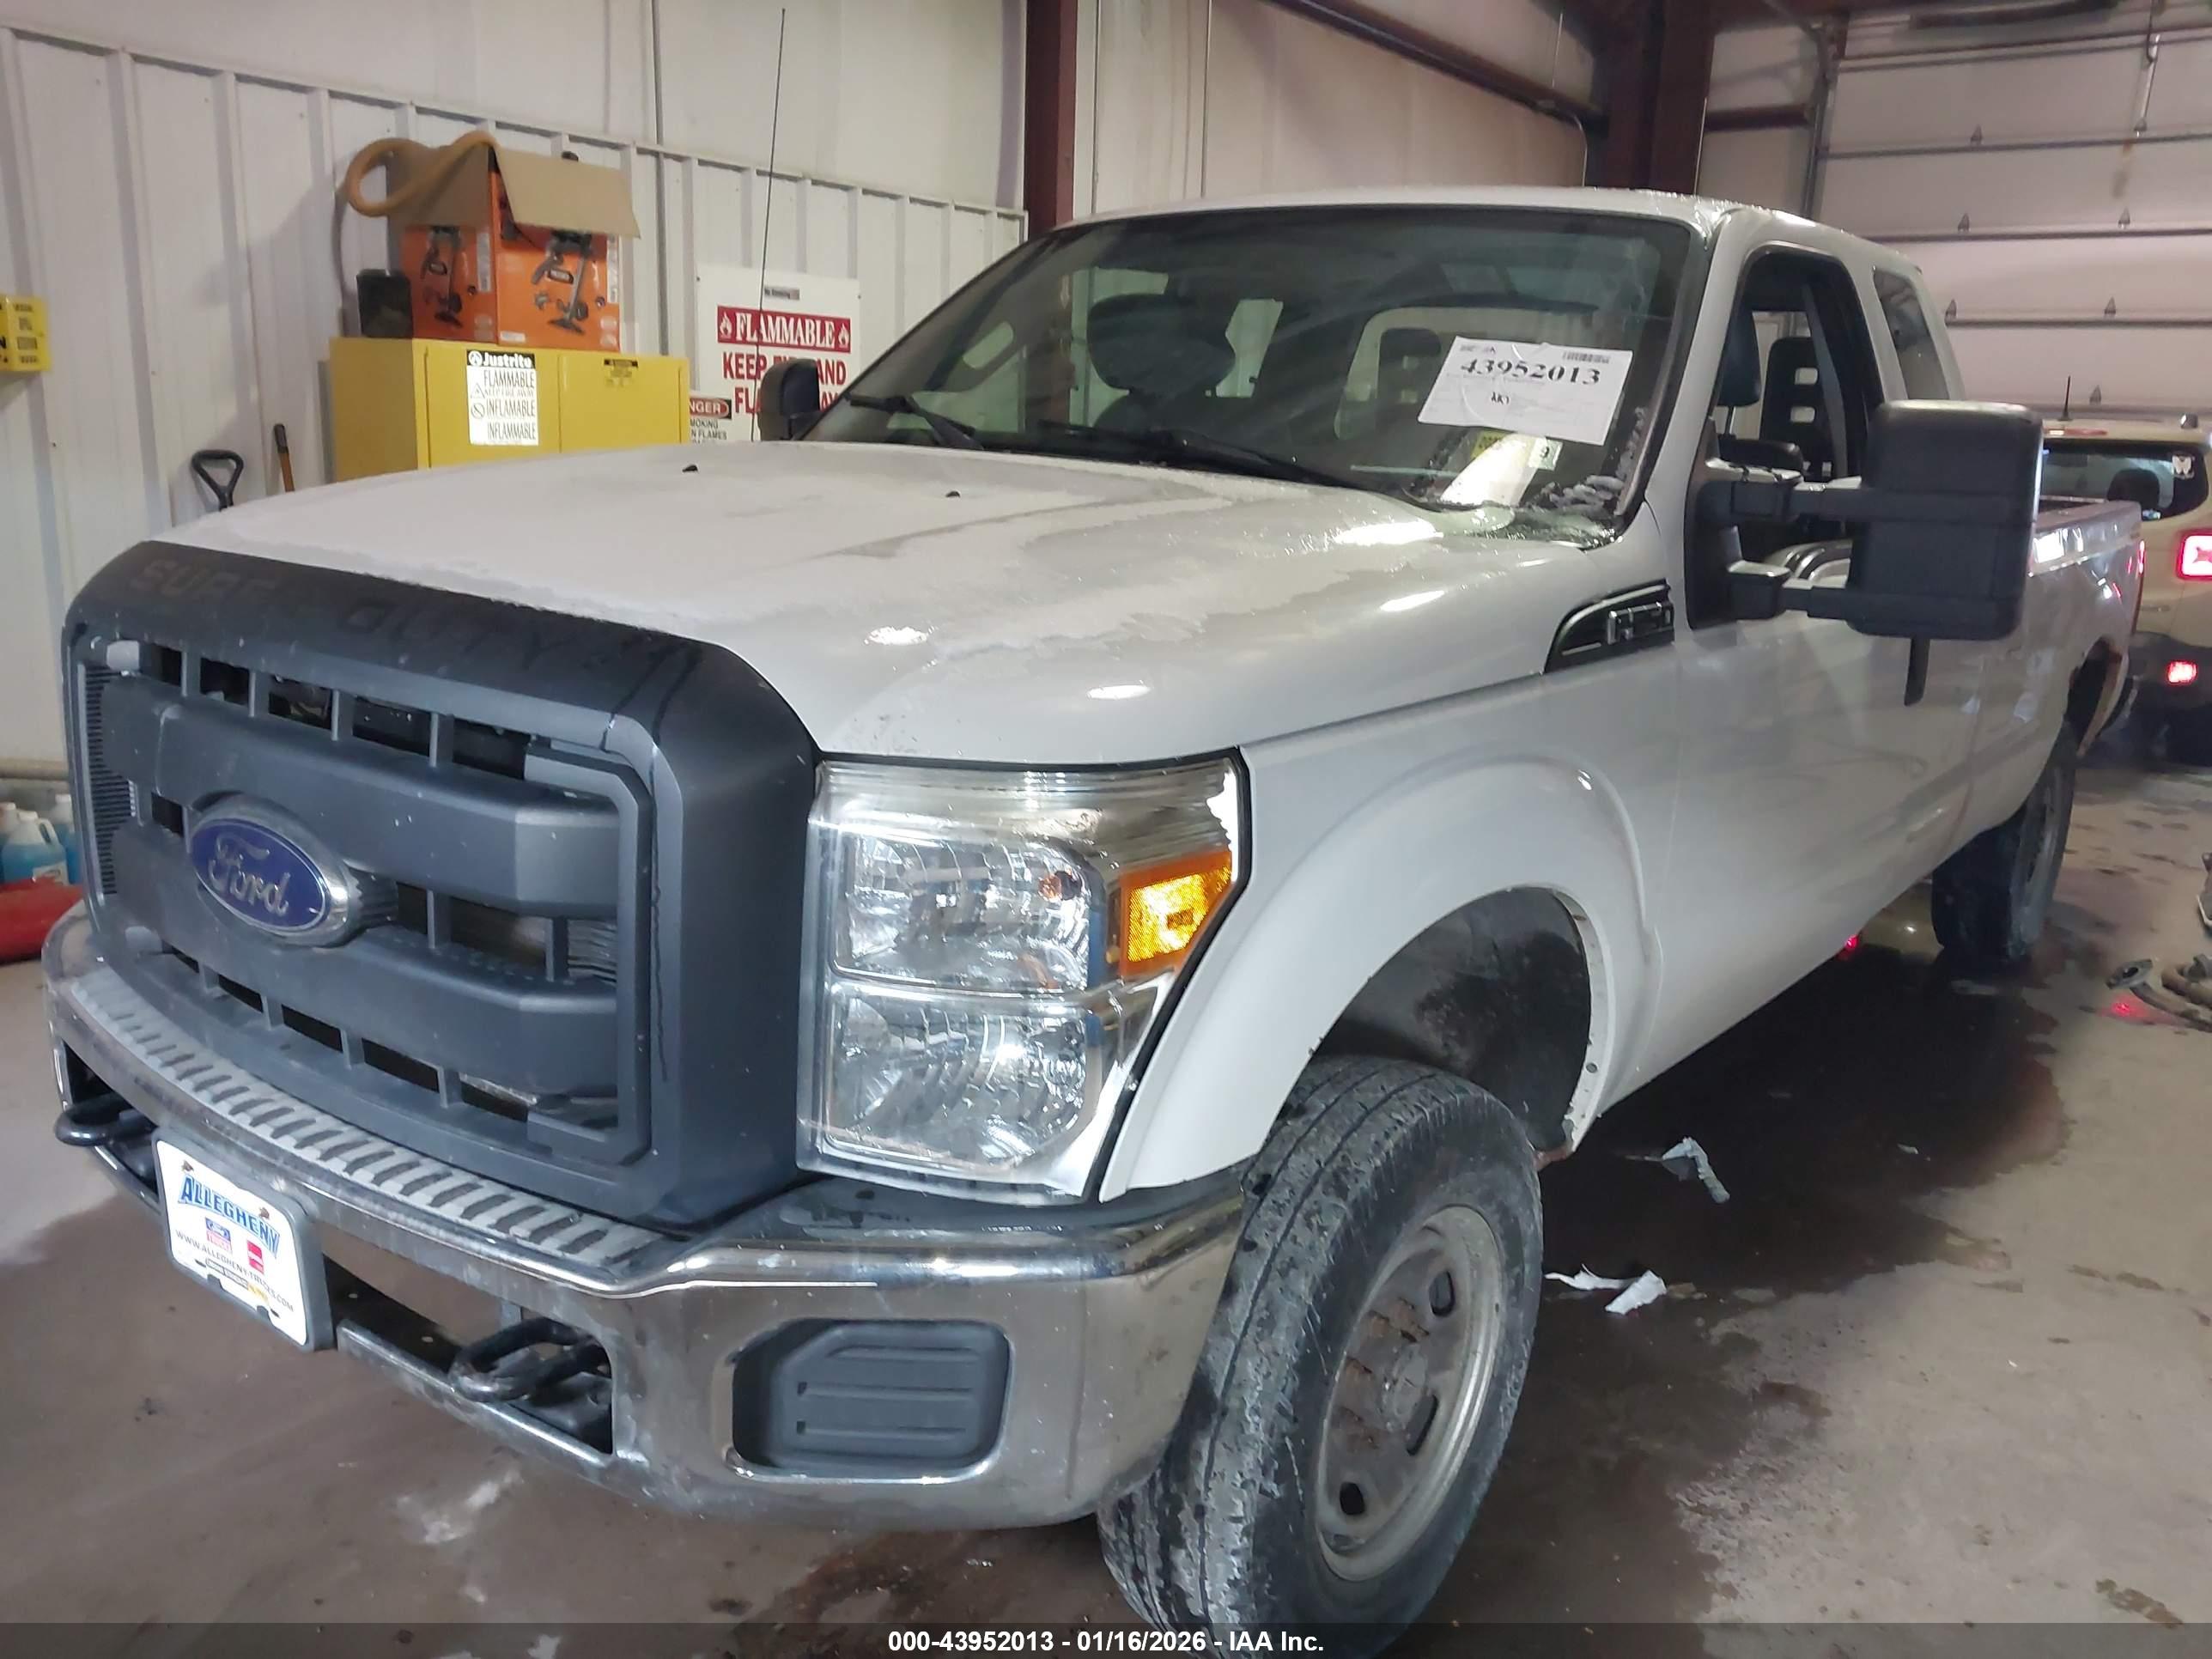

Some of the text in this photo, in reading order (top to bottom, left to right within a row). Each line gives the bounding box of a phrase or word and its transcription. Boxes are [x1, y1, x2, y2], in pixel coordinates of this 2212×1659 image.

[735, 312, 836, 349] FLAMMABLE
[483, 352, 533, 368] Justrite
[722, 351, 768, 380] KEEP
[1461, 358, 1601, 386] 43952013
[483, 369, 535, 389] FLAMMABLE
[689, 400, 721, 414] NGER
[208, 832, 292, 917] Ford
[179, 1175, 280, 1257] ALLEGHENY
